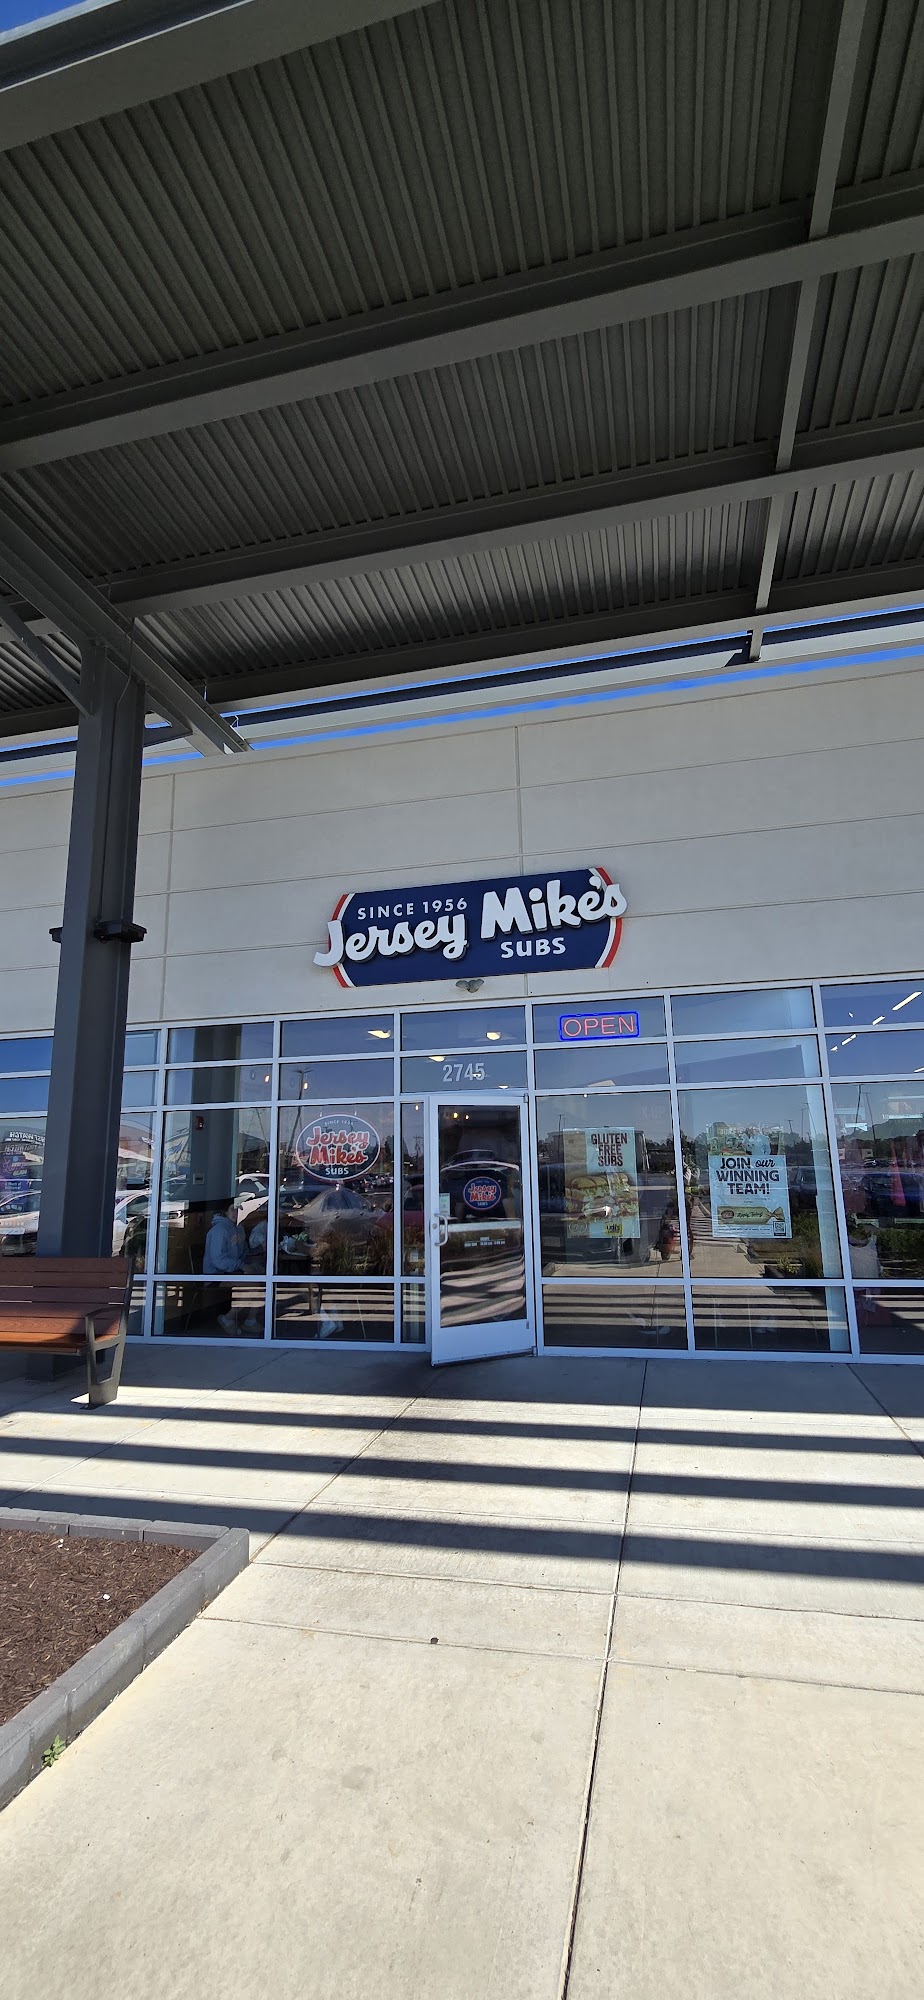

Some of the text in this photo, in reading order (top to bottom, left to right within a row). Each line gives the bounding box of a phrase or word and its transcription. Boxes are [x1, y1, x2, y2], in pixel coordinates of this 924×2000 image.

[357, 897, 467, 919] SINCE 1956
[313, 876, 628, 967] Jersey Mike's
[500, 937, 566, 959] SUBS
[562, 1015, 635, 1037] OPEN
[442, 1062, 486, 1083] 2745
[306, 1126, 369, 1150] Jersey
[591, 1132, 628, 1145] GLUTEN
[309, 1145, 368, 1166] Mike's
[598, 1144, 622, 1156] FREE
[597, 1155, 623, 1167] SUBS
[720, 1157, 776, 1170] JOIN our
[325, 1167, 349, 1175] SUBS
[716, 1170, 780, 1182] WINNING
[468, 1182, 497, 1194] Jersey
[727, 1183, 770, 1195] TEAM!
